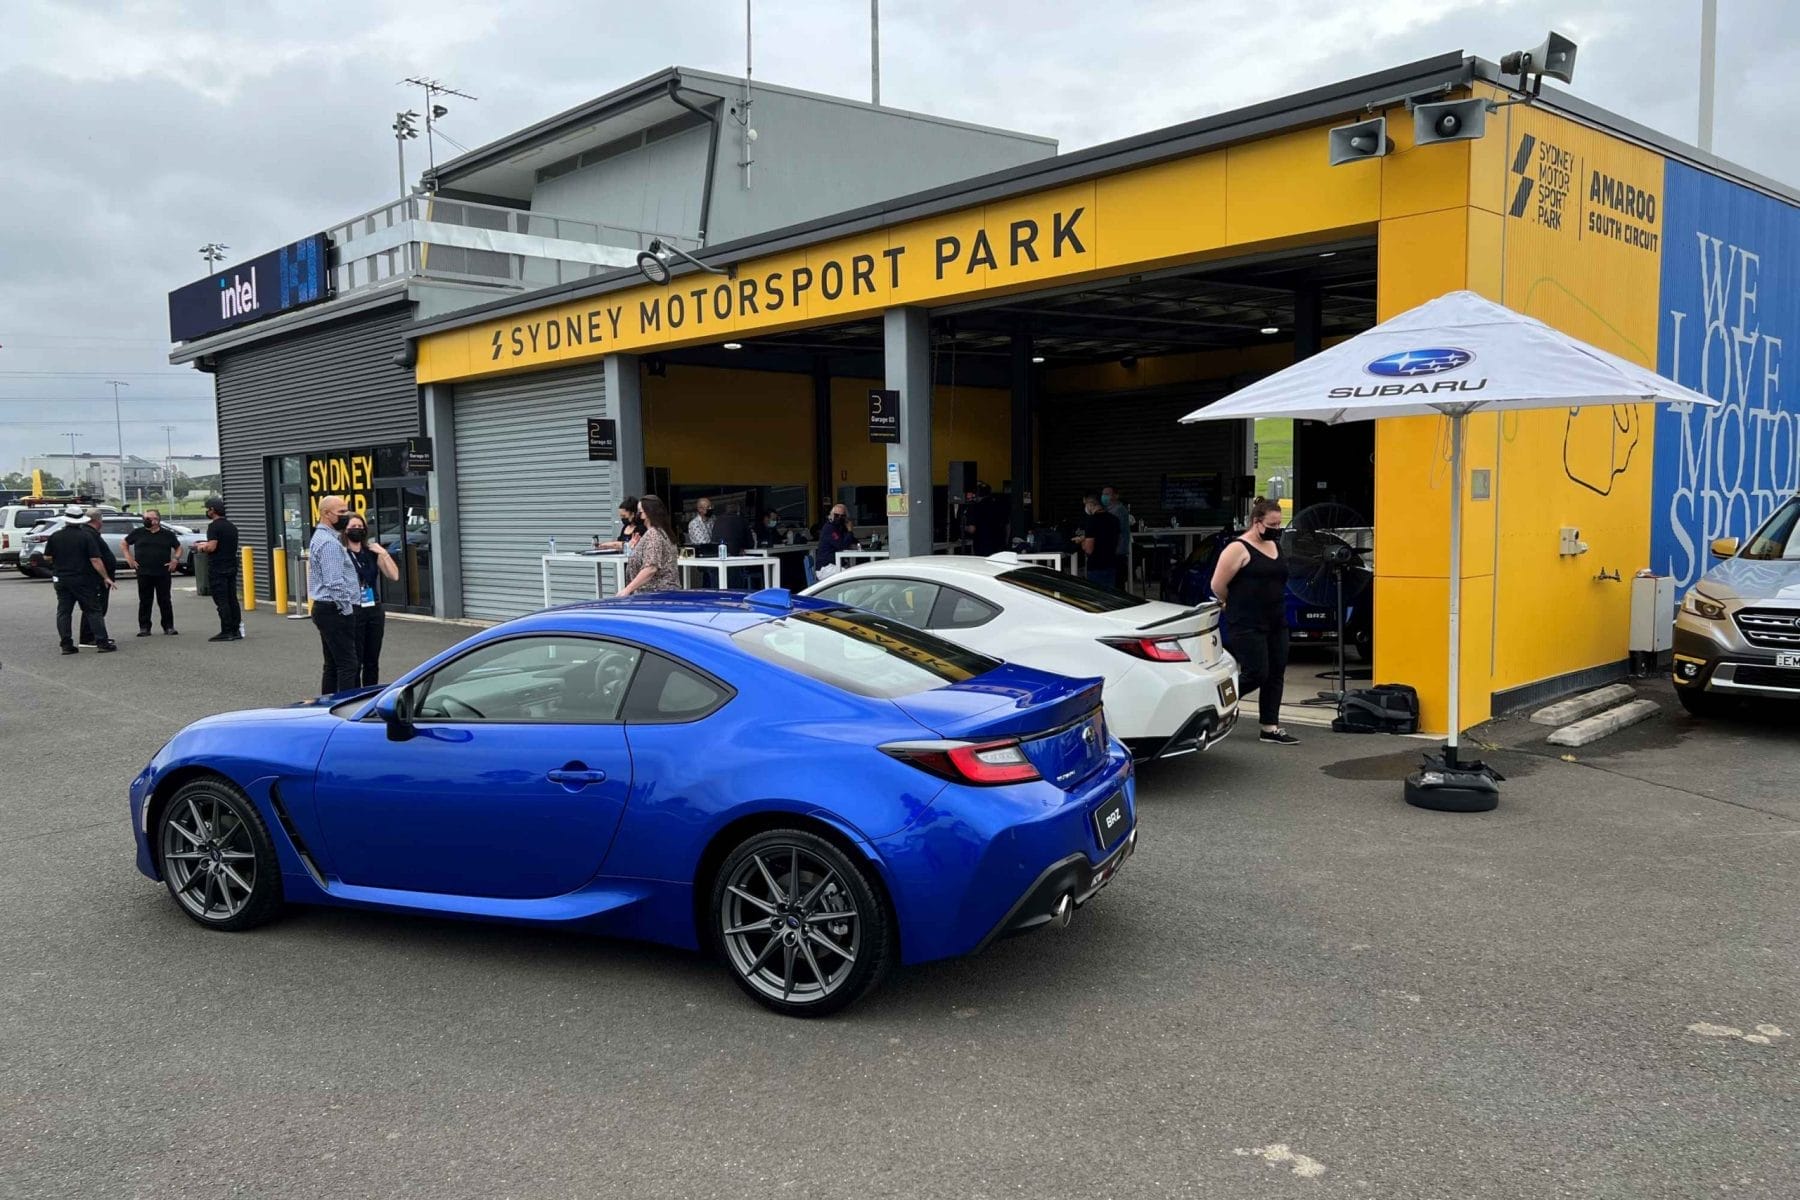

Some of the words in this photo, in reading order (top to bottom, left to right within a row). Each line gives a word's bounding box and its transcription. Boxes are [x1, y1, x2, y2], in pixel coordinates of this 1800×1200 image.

[1539, 141, 1574, 172] SYDNEY
[1539, 163, 1570, 192] MOTOR
[1539, 185, 1567, 210] SPORT
[1590, 171, 1656, 224] AMAROO
[1538, 206, 1562, 231] PARK
[1588, 211, 1622, 241] SOUTH
[1624, 224, 1658, 253] CIRCUIT
[511, 305, 622, 356] SYDNEY
[640, 246, 906, 334] MOTORSPORT
[935, 207, 1087, 280] PARK
[1696, 231, 1760, 344] WE
[1328, 378, 1488, 399] SUBARU
[1669, 401, 1800, 501] MOTO
[309, 455, 373, 493] SYDNEY
[1105, 807, 1122, 829] BRZ
